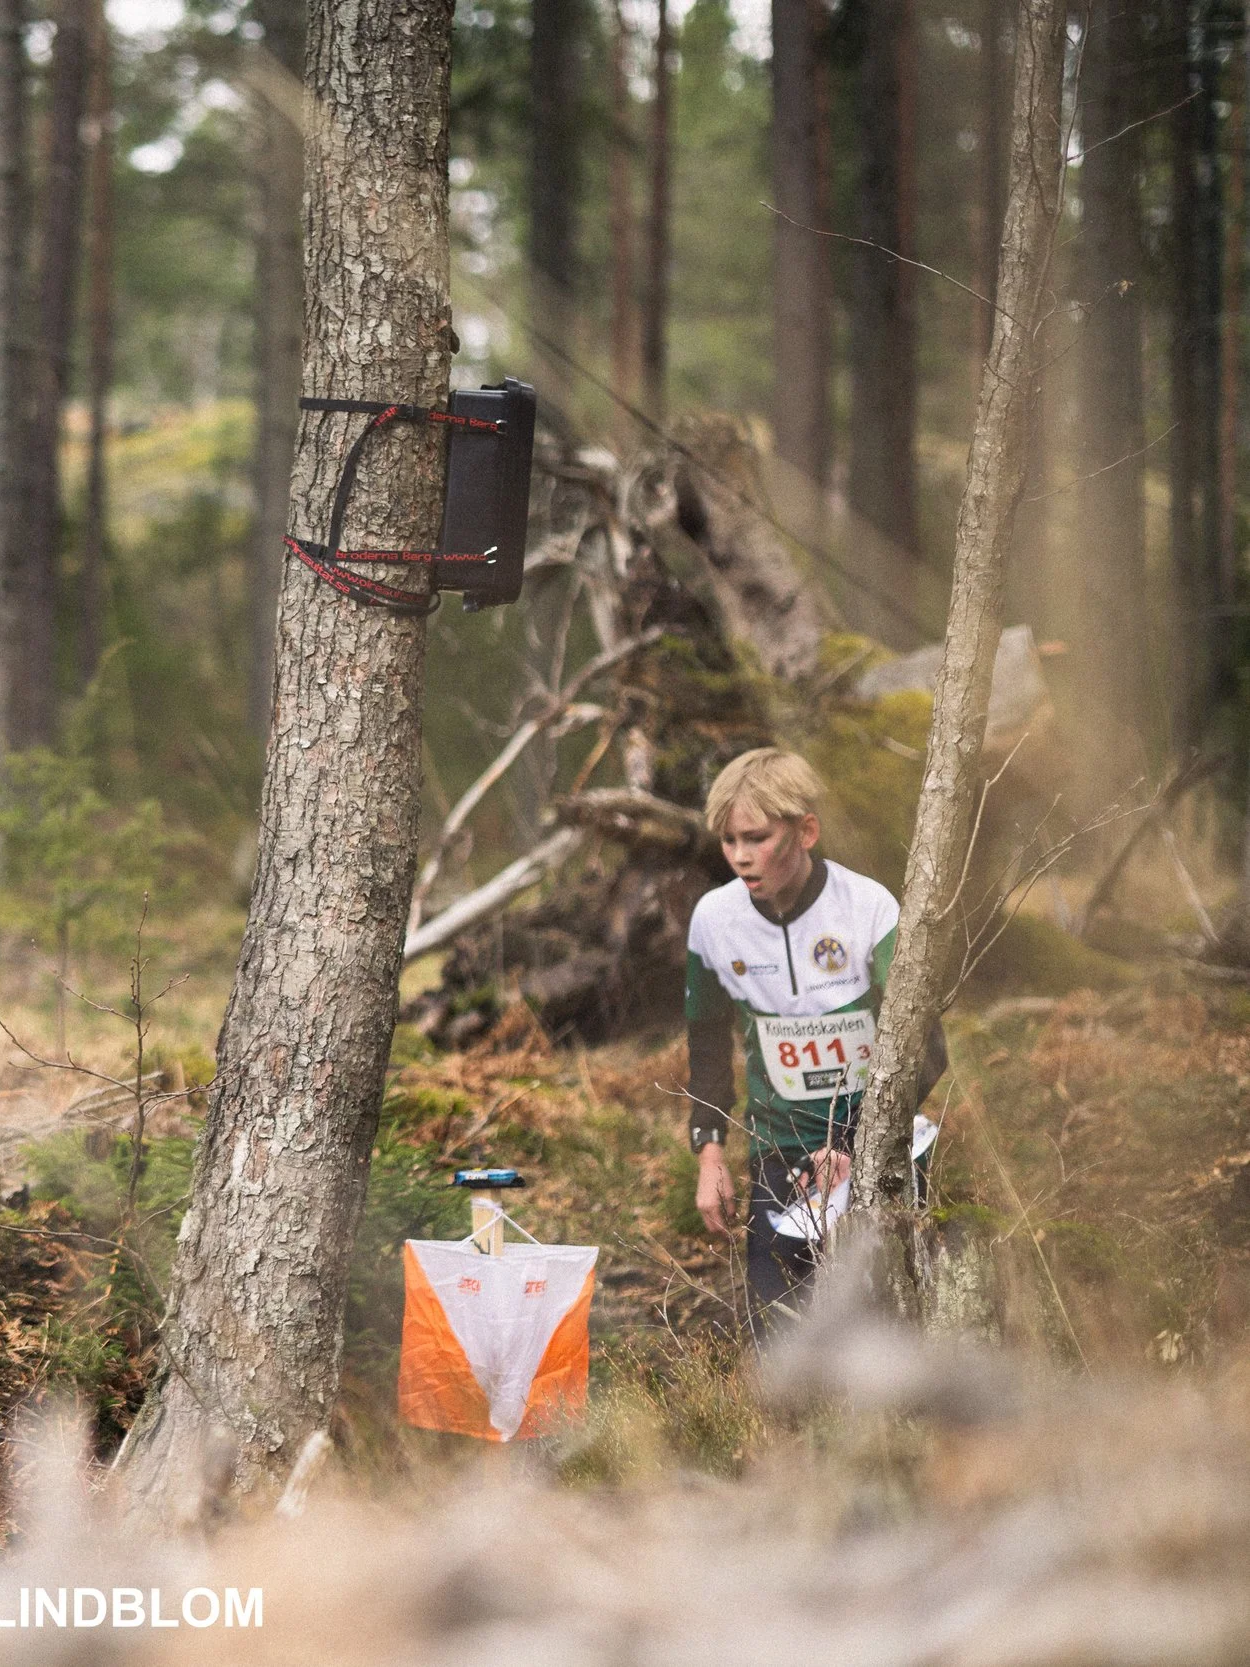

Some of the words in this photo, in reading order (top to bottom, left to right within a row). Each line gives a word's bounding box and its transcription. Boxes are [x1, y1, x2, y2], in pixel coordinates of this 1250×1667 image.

[402, 551, 431, 563] Berg
[778, 1037, 847, 1068] 811
[856, 1045, 871, 1060] 3
